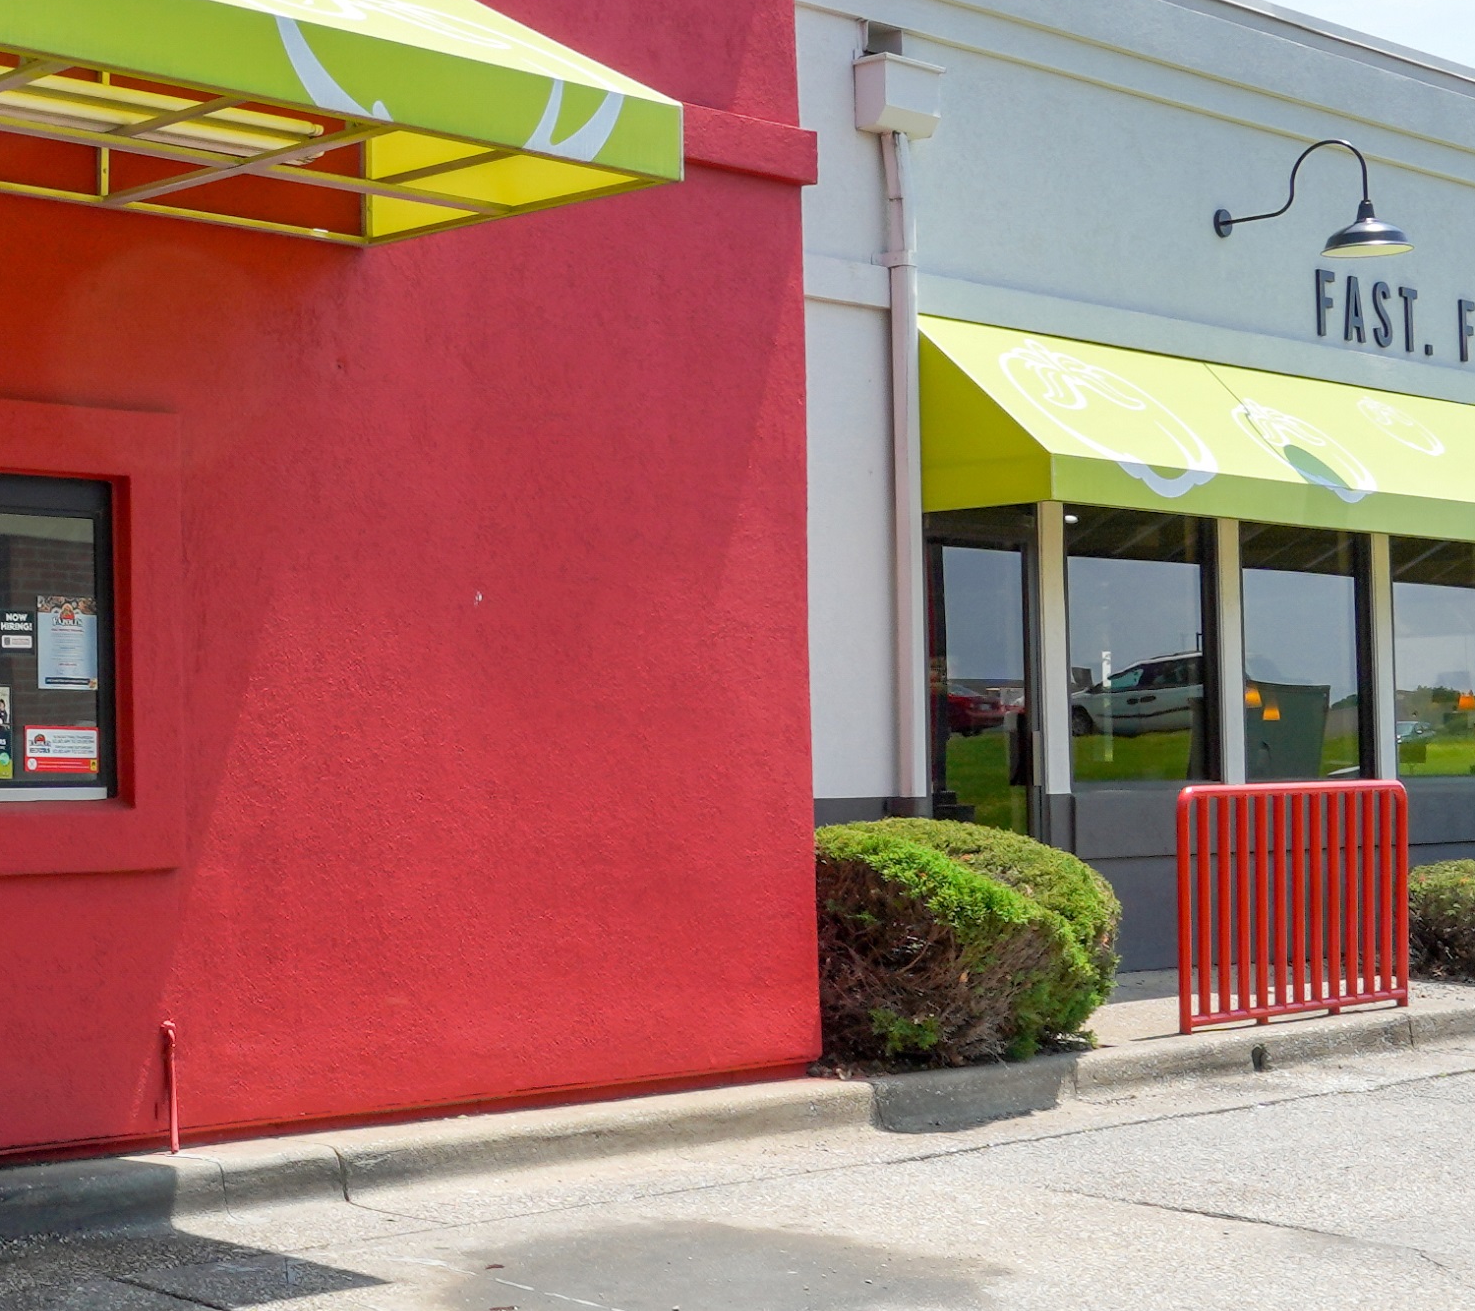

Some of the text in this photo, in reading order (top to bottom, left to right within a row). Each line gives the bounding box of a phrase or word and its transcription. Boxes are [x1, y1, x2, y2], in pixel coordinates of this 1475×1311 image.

[1315, 268, 1434, 356] FAST.
[5, 613, 28, 621] NOW
[0, 622, 32, 631] HIRING!
